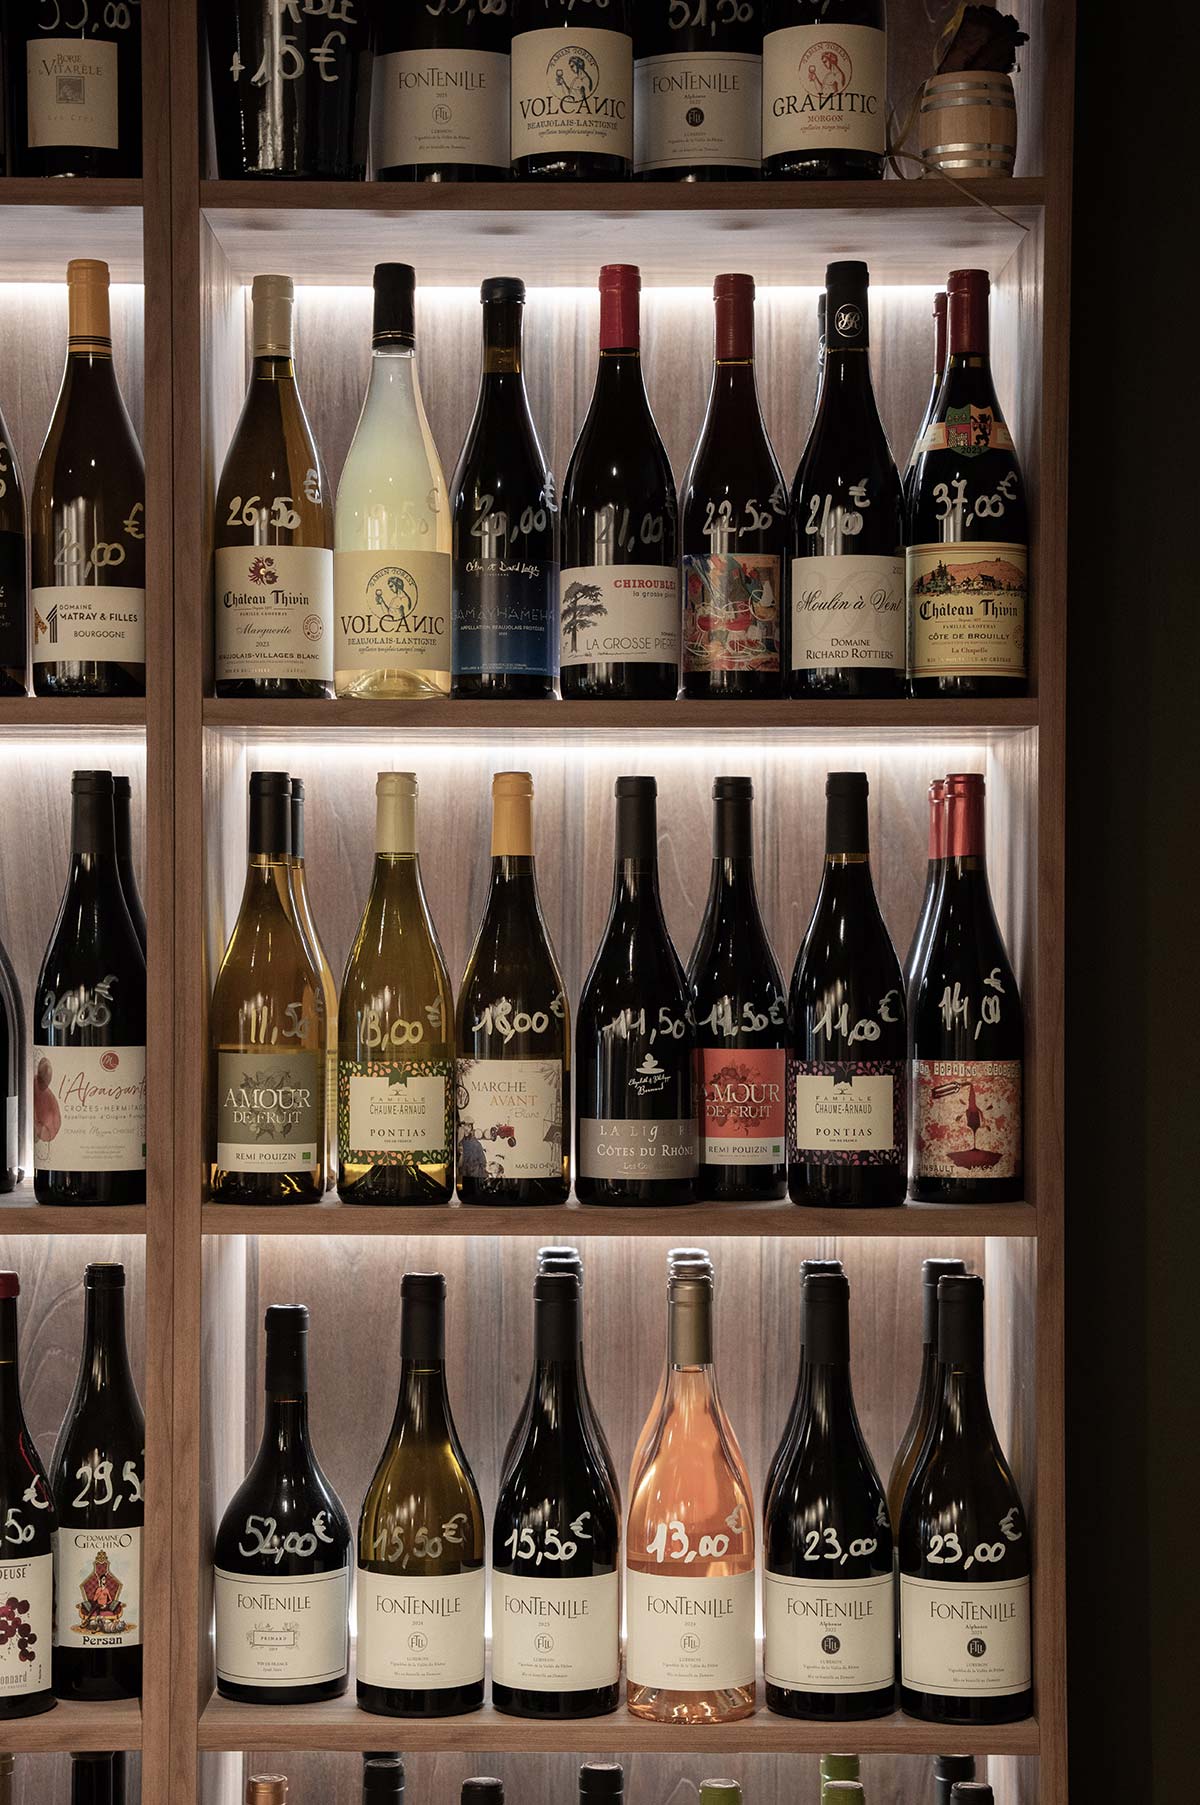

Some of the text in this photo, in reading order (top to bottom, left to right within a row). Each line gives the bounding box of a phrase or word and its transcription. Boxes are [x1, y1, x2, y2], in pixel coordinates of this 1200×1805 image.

[399, 67, 487, 91] FONTENILLE
[652, 71, 740, 94] FONTENILLE
[796, 589, 851, 614] Moulin
[853, 596, 867, 610] à
[60, 612, 138, 623] MATRAY & FILLES
[73, 630, 126, 639] BOURGOGNE
[928, 632, 1010, 641] CÔTE DE BROUILLY
[586, 637, 652, 651] LA GROSSE
[831, 638, 871, 647] DOMAINE
[296, 652, 320, 660] BLANC
[806, 649, 894, 661] RICHARD ROTTIERS
[471, 1081, 527, 1093] MARCHE
[223, 1087, 312, 1110] AMOUR
[489, 1095, 539, 1107] AVANT
[730, 1105, 773, 1119] FRUIT
[814, 1102, 873, 1114] CHAUME-ARNAUD
[232, 1110, 302, 1124] DE FRUIT
[370, 1128, 427, 1137] PONTIAS
[815, 1128, 873, 1137] PONTIAS
[596, 1143, 636, 1157] CÔTES
[639, 1146, 657, 1157] DU
[732, 1145, 768, 1154] POUIZIN
[258, 1152, 297, 1161] POUIZIN
[237, 1593, 311, 1613] FONTENILLE
[376, 1595, 462, 1617] FONTENILLE
[504, 1595, 590, 1619] FONTENILLE
[647, 1595, 734, 1619] FONTENILLE
[787, 1597, 874, 1620] FONTENILLE
[930, 1601, 1017, 1623] FONTENILLE
[82, 1635, 122, 1646] Persan
